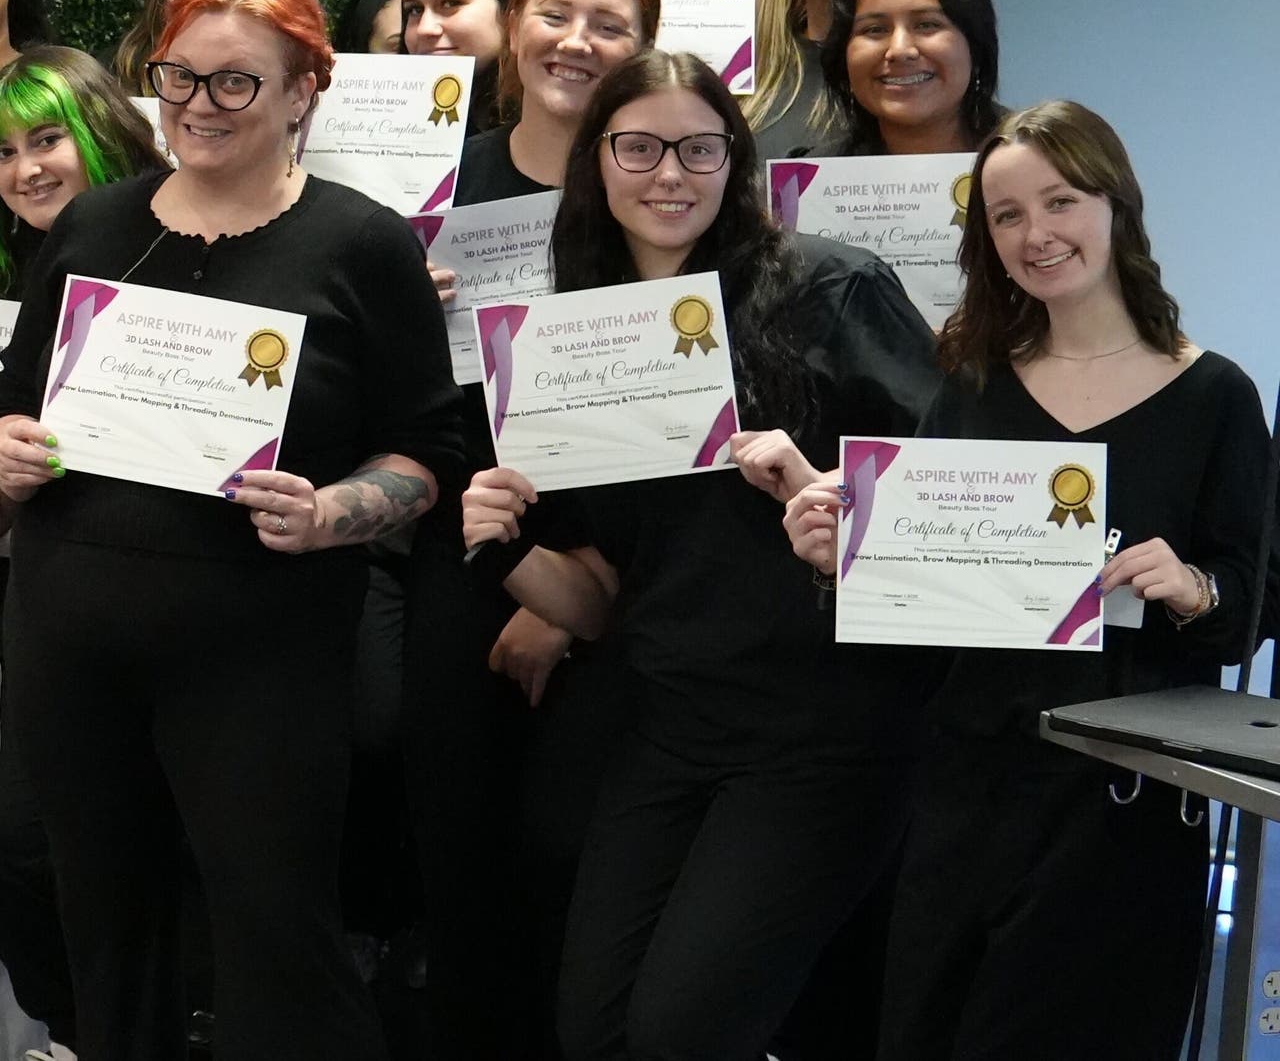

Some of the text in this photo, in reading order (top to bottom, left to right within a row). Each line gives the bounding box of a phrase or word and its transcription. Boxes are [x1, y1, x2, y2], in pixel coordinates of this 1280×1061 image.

[823, 182, 940, 197] ASPIRE WITH AMY
[848, 205, 871, 213] LASH
[872, 204, 891, 212] AND
[893, 203, 921, 212] BROW
[451, 218, 554, 245] ASPIRE WITH AM
[874, 230, 887, 248] of
[889, 226, 951, 246] Completion
[463, 238, 547, 259] 3D LASH AND BROW
[505, 268, 517, 287] of
[116, 312, 238, 342] ASPIRE WITH AMY
[536, 309, 658, 339] ASPIRE WITH AMY
[124, 334, 213, 357] 3D LASH AND BROW
[550, 334, 641, 355] 3D LASH AND BROW
[100, 355, 237, 394] Certificate of Completion
[535, 358, 677, 391] Certificate of Completion
[77, 385, 119, 399] Lamination,
[120, 393, 140, 402] Brow
[140, 396, 173, 410] Mapping
[180, 404, 218, 418] Threading
[219, 411, 274, 427] Demonstration
[903, 469, 1038, 485] ASPIRE WITH AMY
[916, 492, 1015, 503] 3D LASH AND BROW
[894, 516, 1048, 543] Certificate of Completion
[851, 553, 872, 561] Brow
[873, 554, 921, 563] Lamination,
[923, 555, 944, 563] Brow
[946, 556, 981, 566] Mapping
[991, 557, 1032, 567] Threading
[1034, 558, 1093, 567] Demonstration
